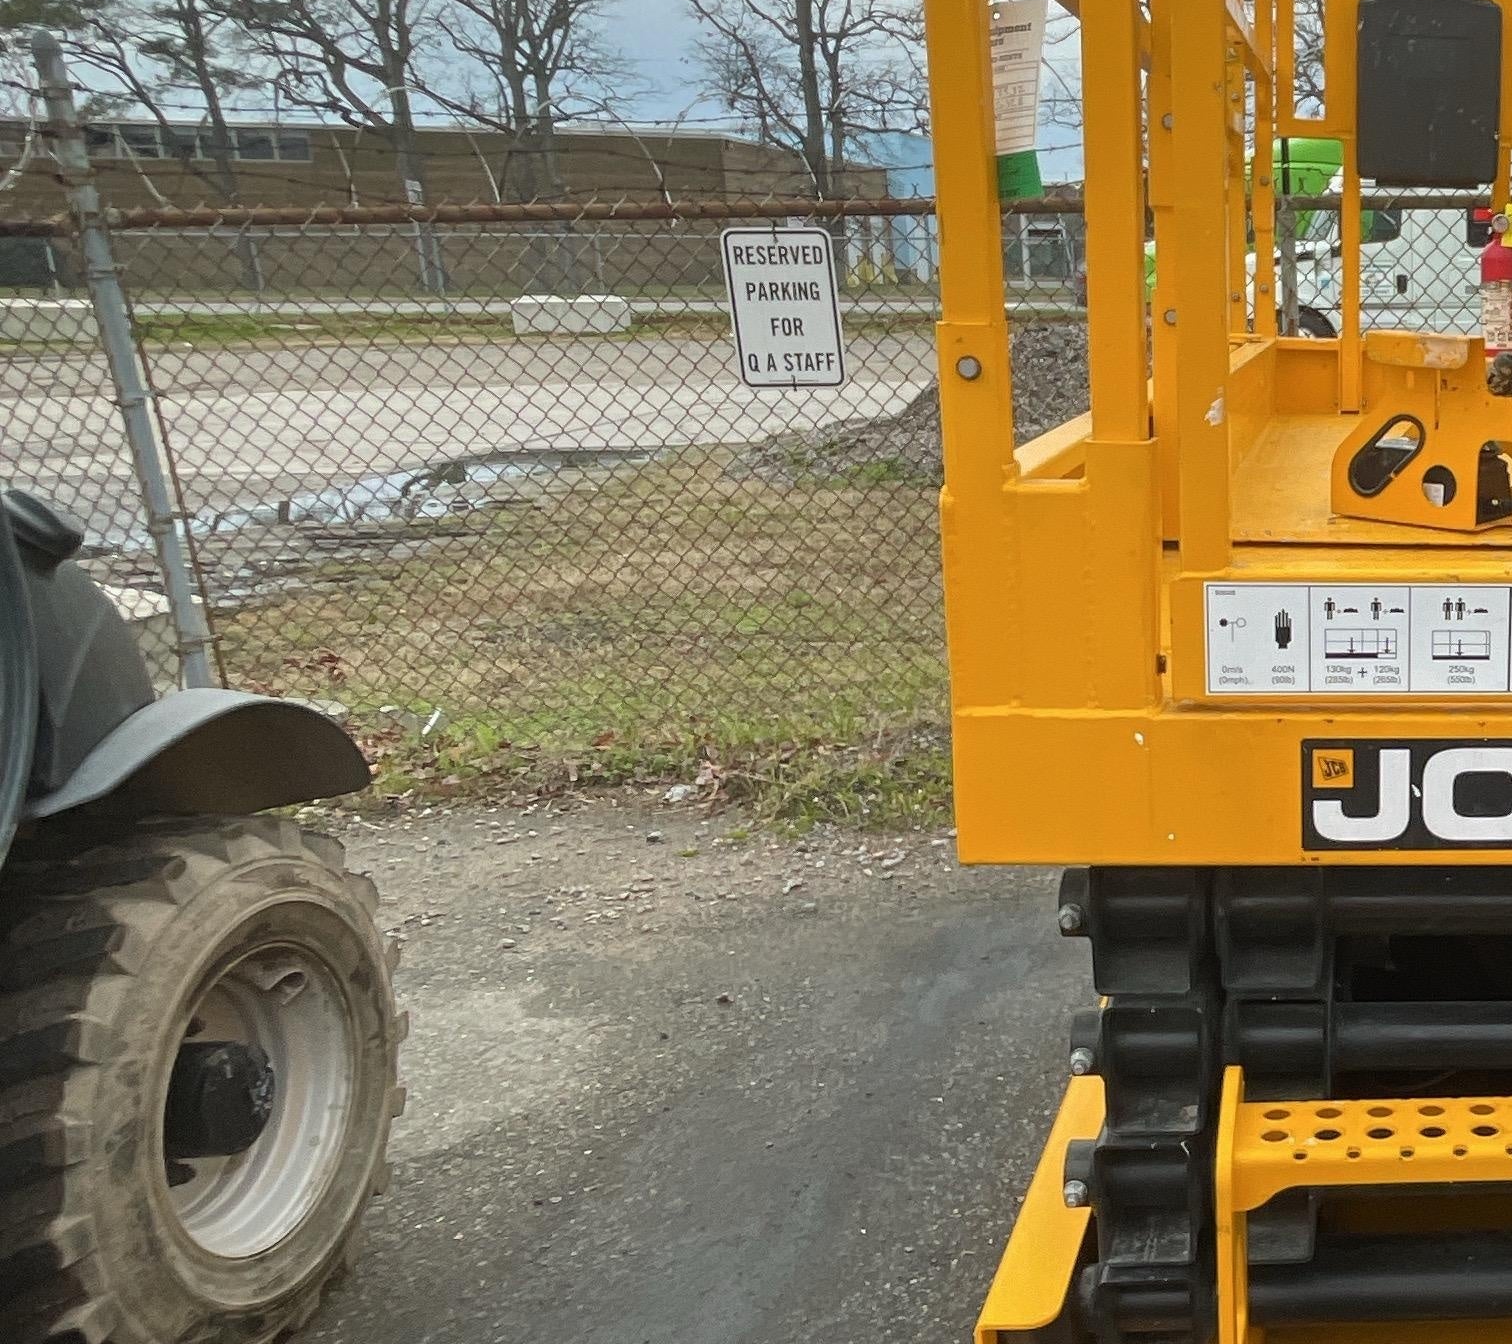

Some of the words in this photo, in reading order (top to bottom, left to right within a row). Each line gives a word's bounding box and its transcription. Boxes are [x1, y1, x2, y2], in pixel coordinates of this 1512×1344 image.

[732, 245, 824, 265] RESERVED
[745, 281, 820, 301] PARKING
[771, 317, 804, 336] FOR
[749, 353, 760, 372] Q
[767, 353, 777, 371] A
[784, 353, 835, 371] STAFF
